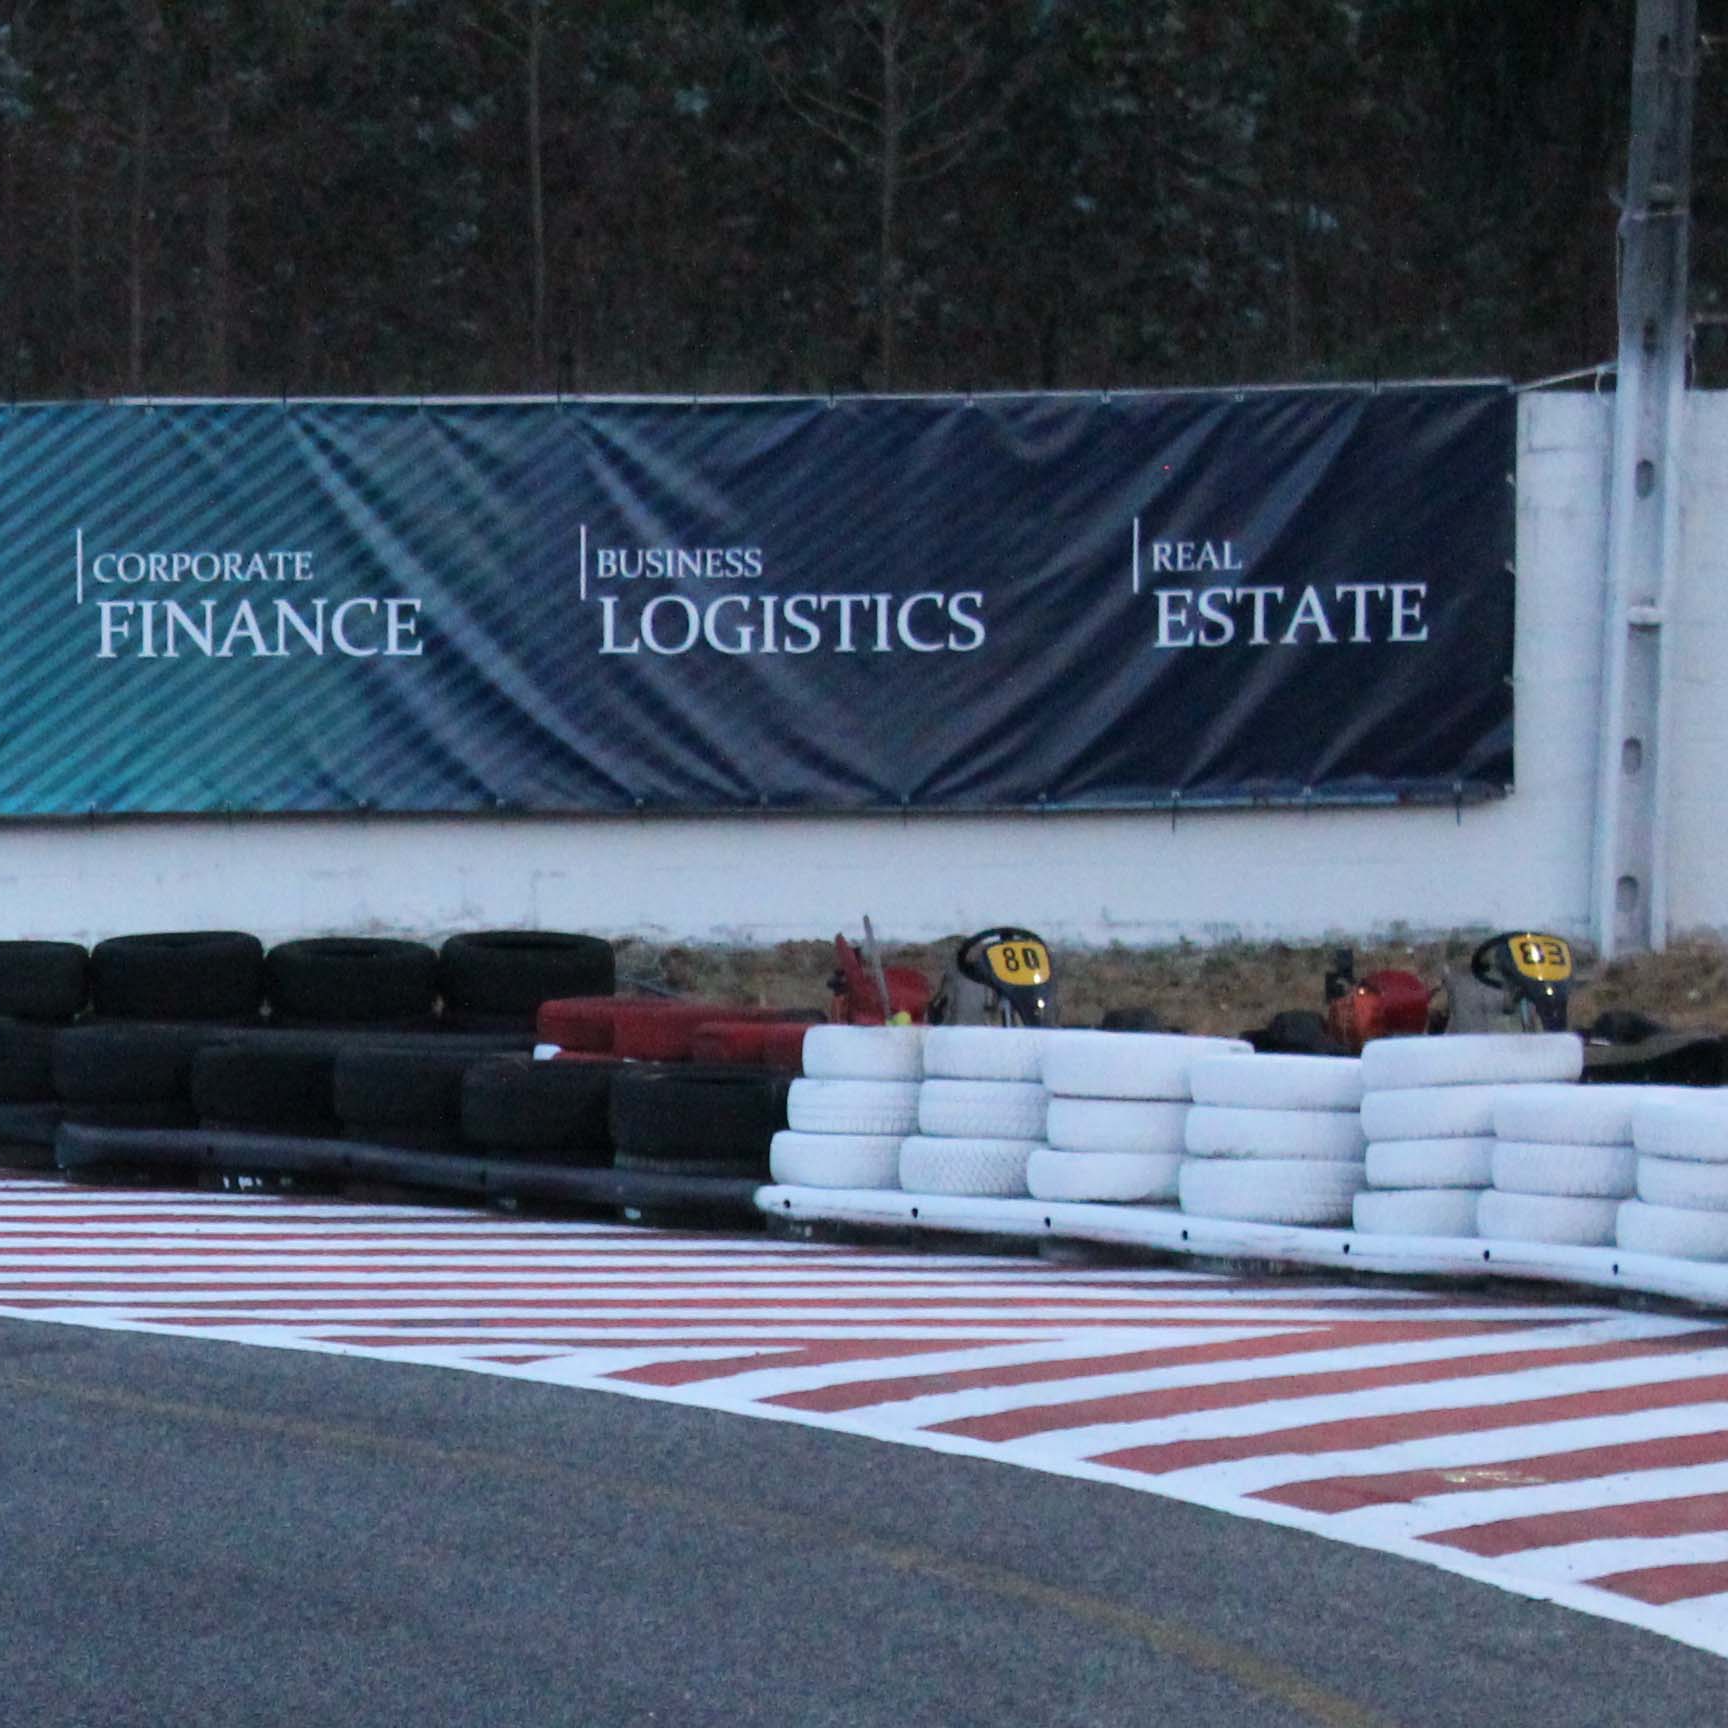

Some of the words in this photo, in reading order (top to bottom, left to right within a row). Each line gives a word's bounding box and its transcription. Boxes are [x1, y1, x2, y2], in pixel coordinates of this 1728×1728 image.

[93, 550, 314, 584] CORPORATE
[596, 546, 763, 579] BUSINESS
[1152, 540, 1242, 573] REAL
[96, 597, 424, 660] FINANCE
[598, 591, 987, 656] LOGISTICS
[1153, 582, 1429, 648] ESTATE
